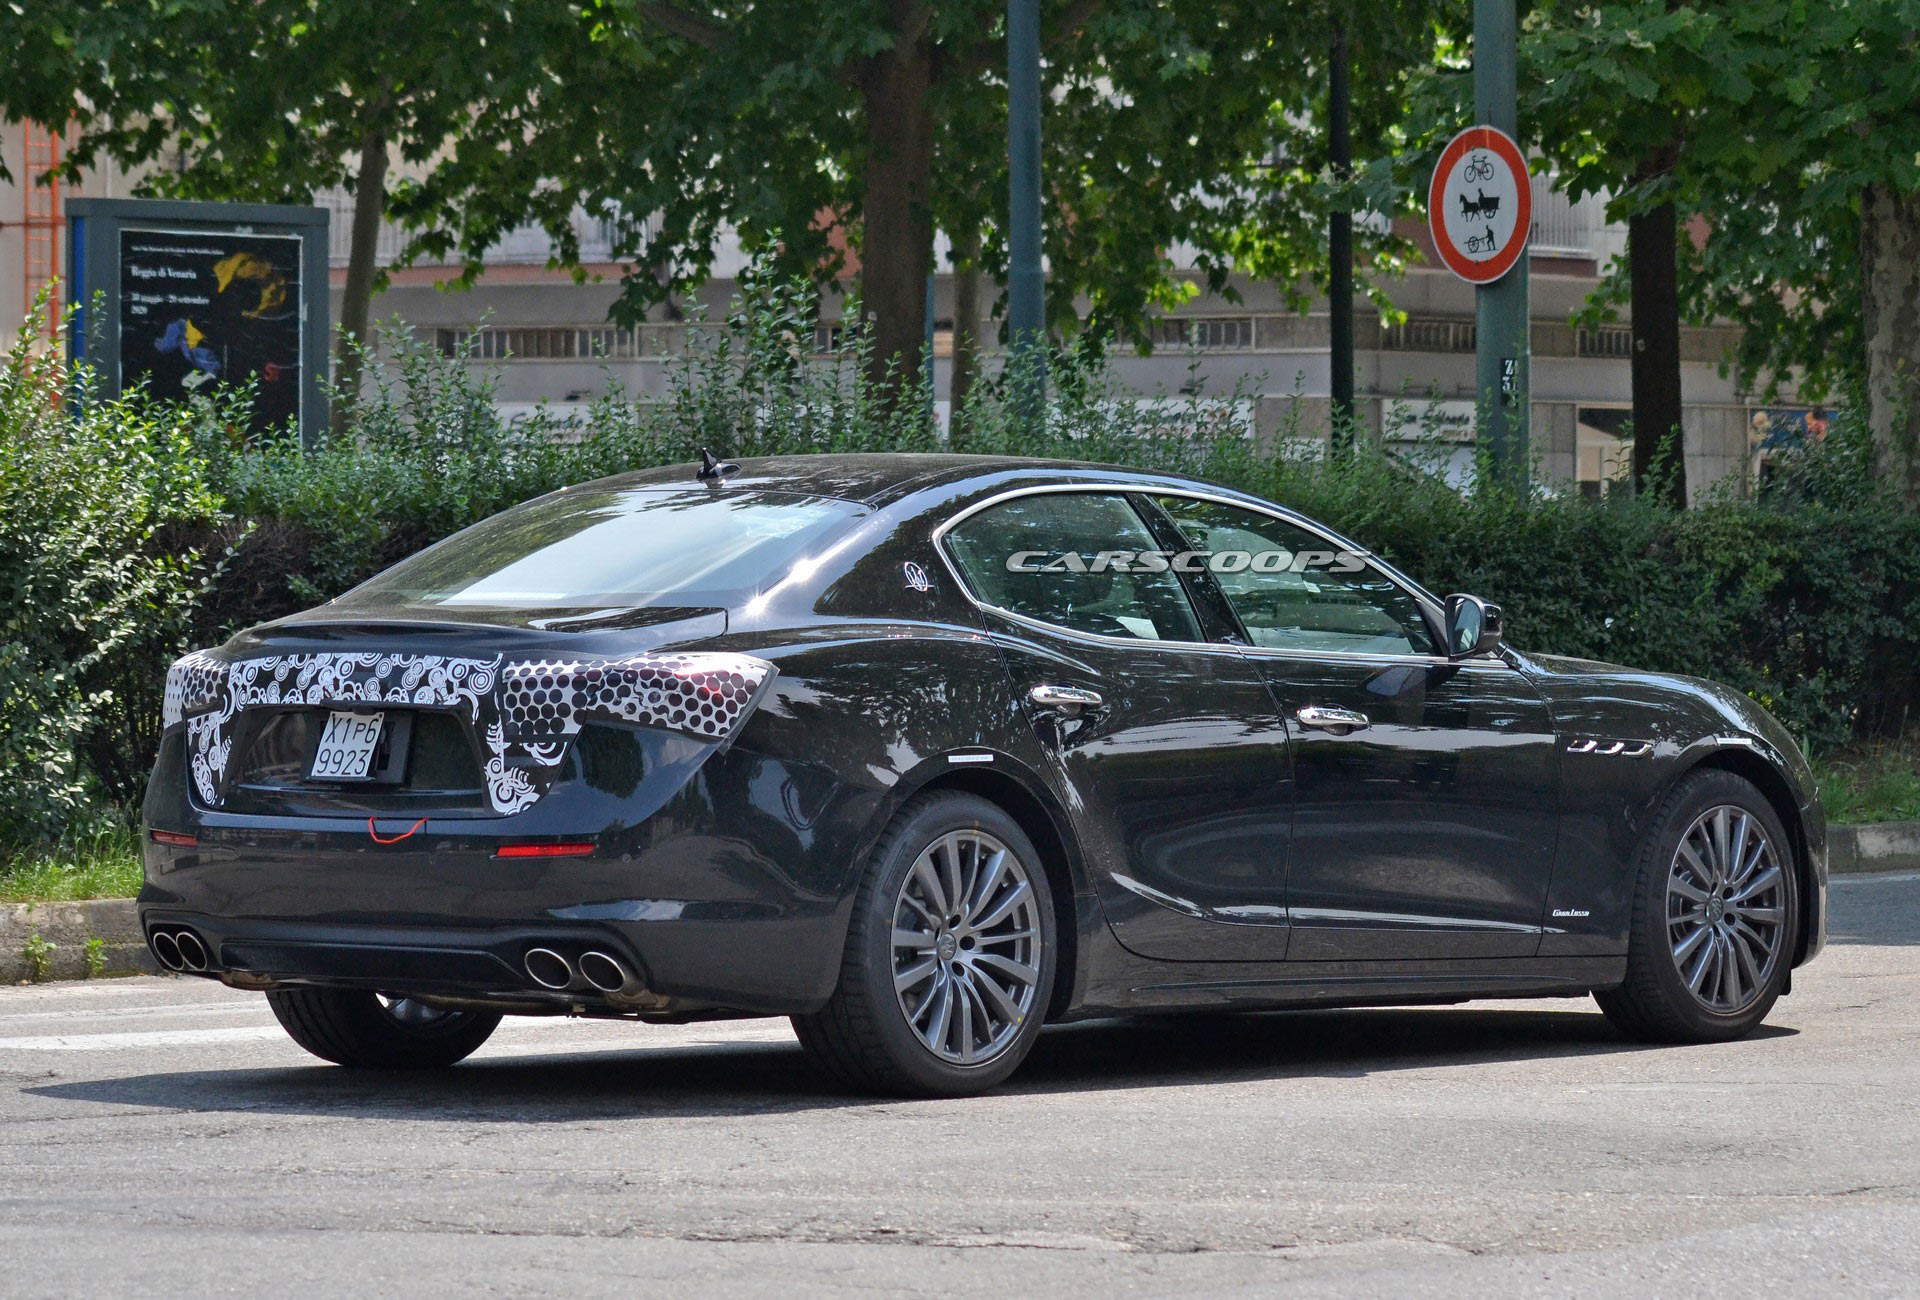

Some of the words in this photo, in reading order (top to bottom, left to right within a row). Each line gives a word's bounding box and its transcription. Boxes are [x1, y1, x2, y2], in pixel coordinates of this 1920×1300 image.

[131, 265, 157, 279] Reggia
[158, 266, 166, 277] di
[167, 267, 197, 279] Venaria
[178, 296, 210, 305] settembre
[324, 717, 380, 744] X1P6
[316, 748, 370, 776] 9923
